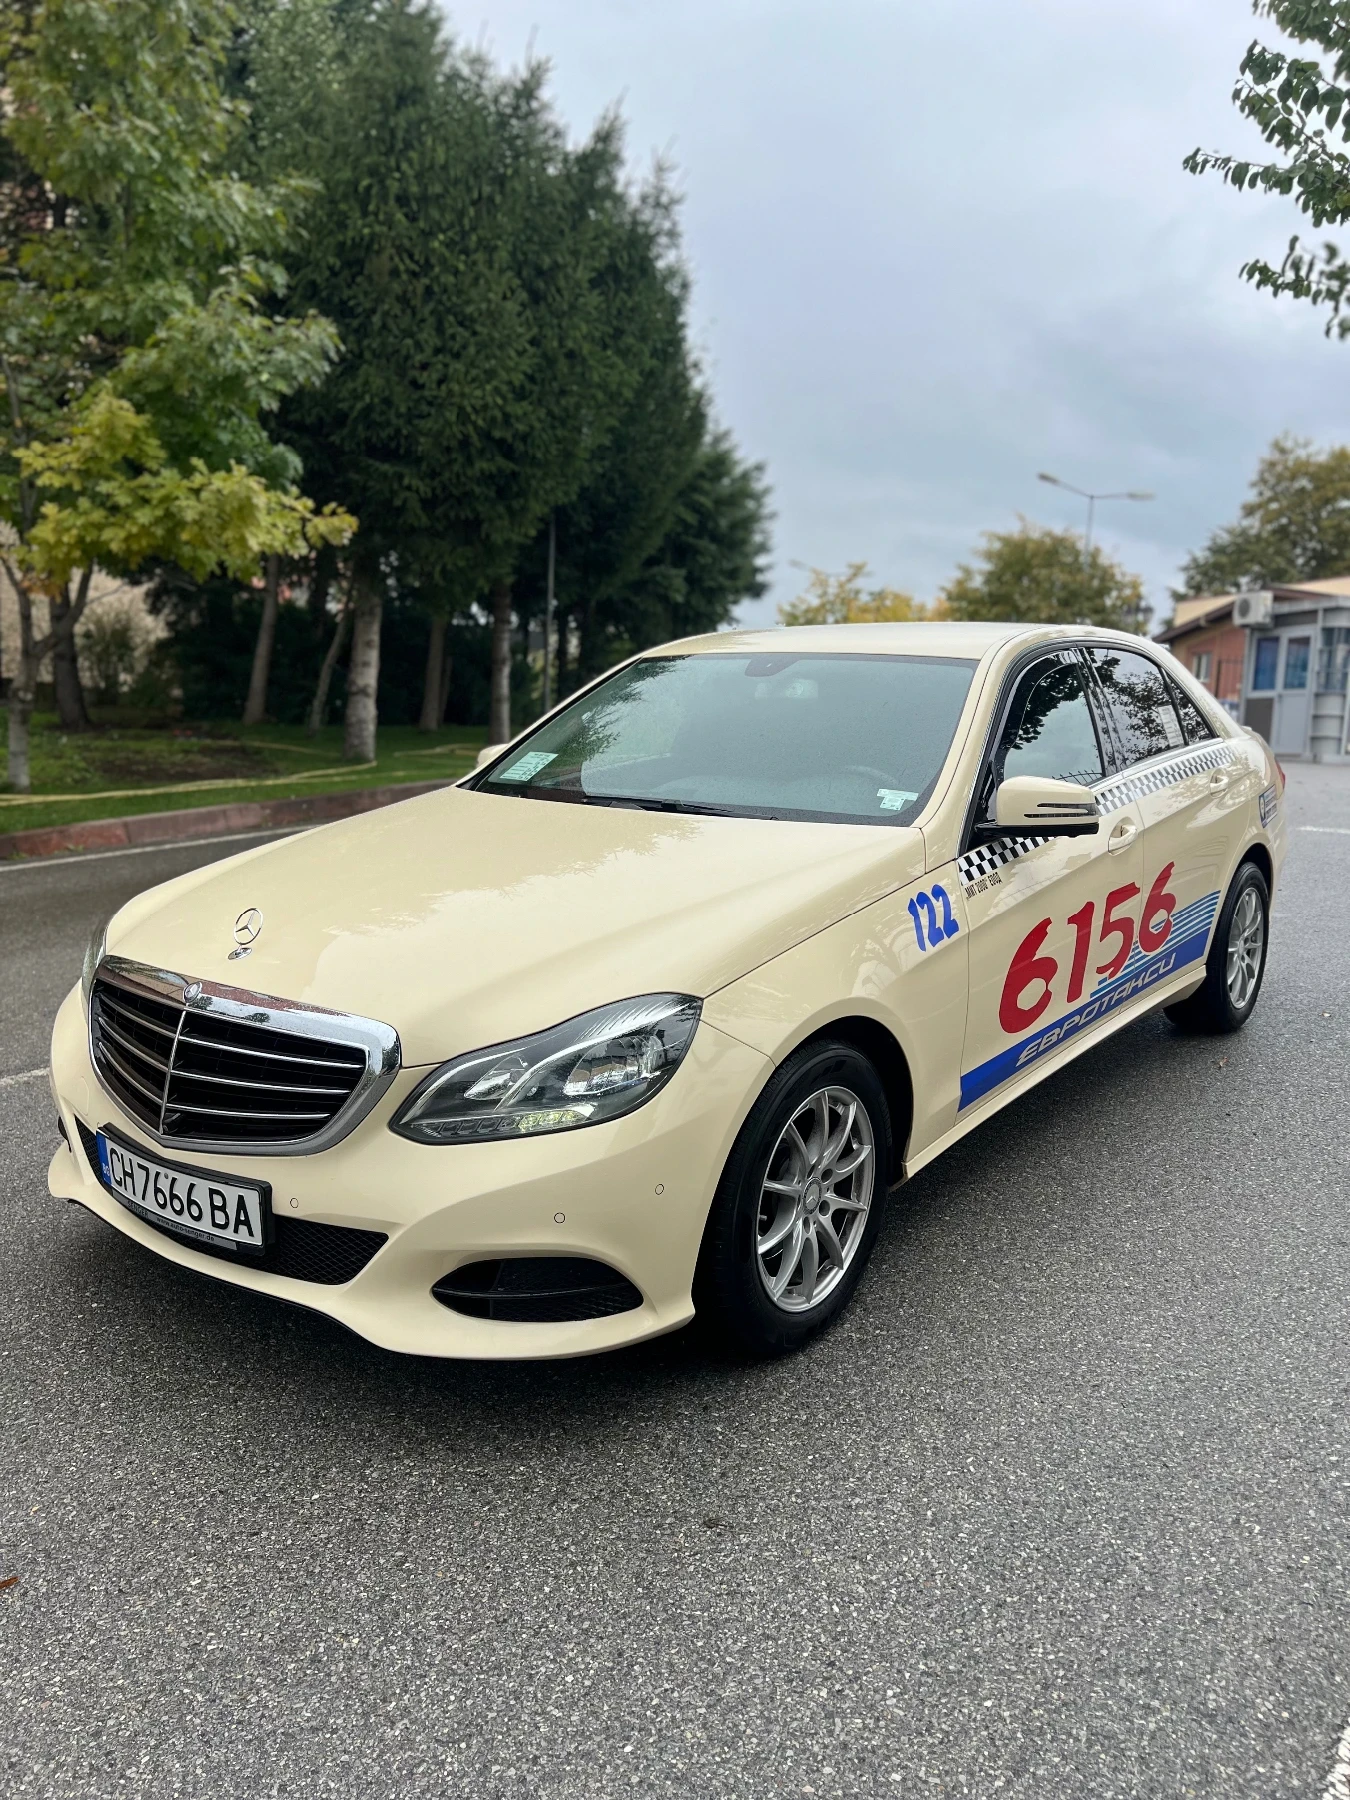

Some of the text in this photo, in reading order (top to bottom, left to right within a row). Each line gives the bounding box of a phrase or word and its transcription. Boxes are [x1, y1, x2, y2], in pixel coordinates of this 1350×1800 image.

[907, 884, 959, 952] 122
[998, 861, 1176, 1034] 6156
[1015, 952, 1176, 1067] ЕВРОТАКСИ
[127, 1200, 149, 1218] SENGER
[156, 1216, 215, 1242] www.auto-senger.de
